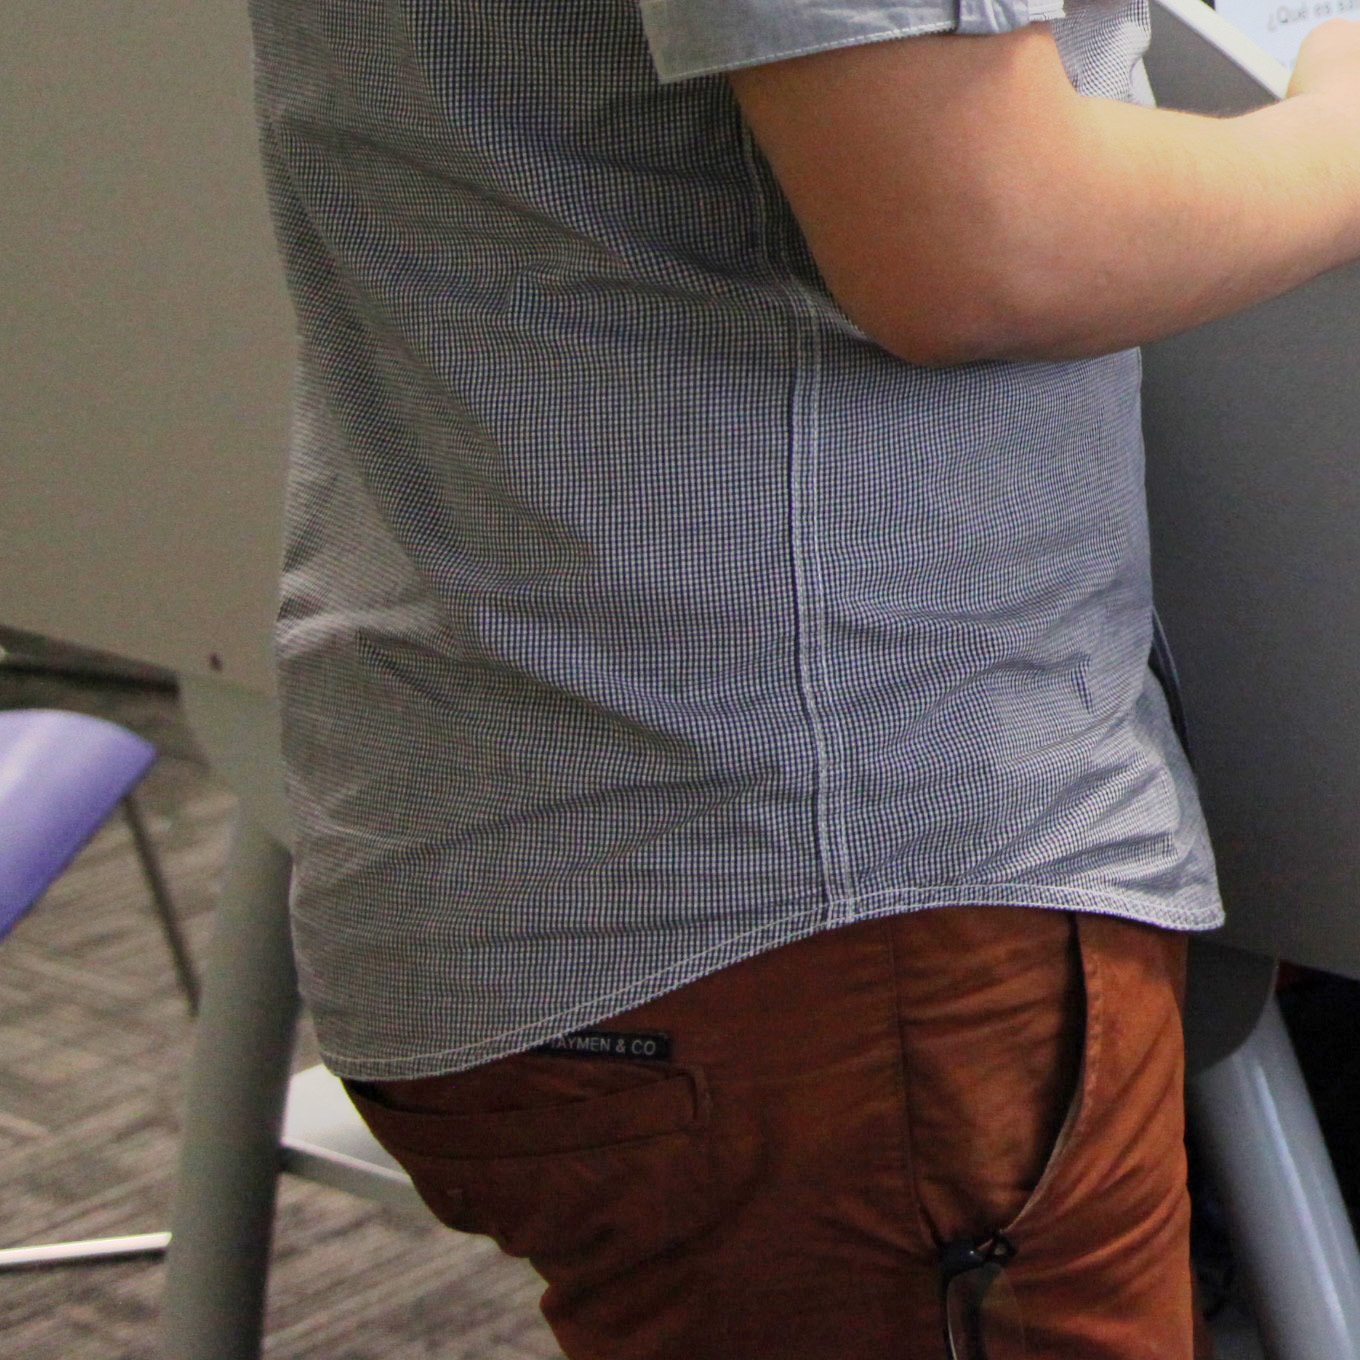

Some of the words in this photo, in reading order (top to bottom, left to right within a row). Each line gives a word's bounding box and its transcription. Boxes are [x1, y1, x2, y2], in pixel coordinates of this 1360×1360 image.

[1267, 0, 1308, 32] ¿Qué
[1313, 1, 1333, 16] es
[616, 1038, 626, 1053] &
[631, 1039, 656, 1056] CO
